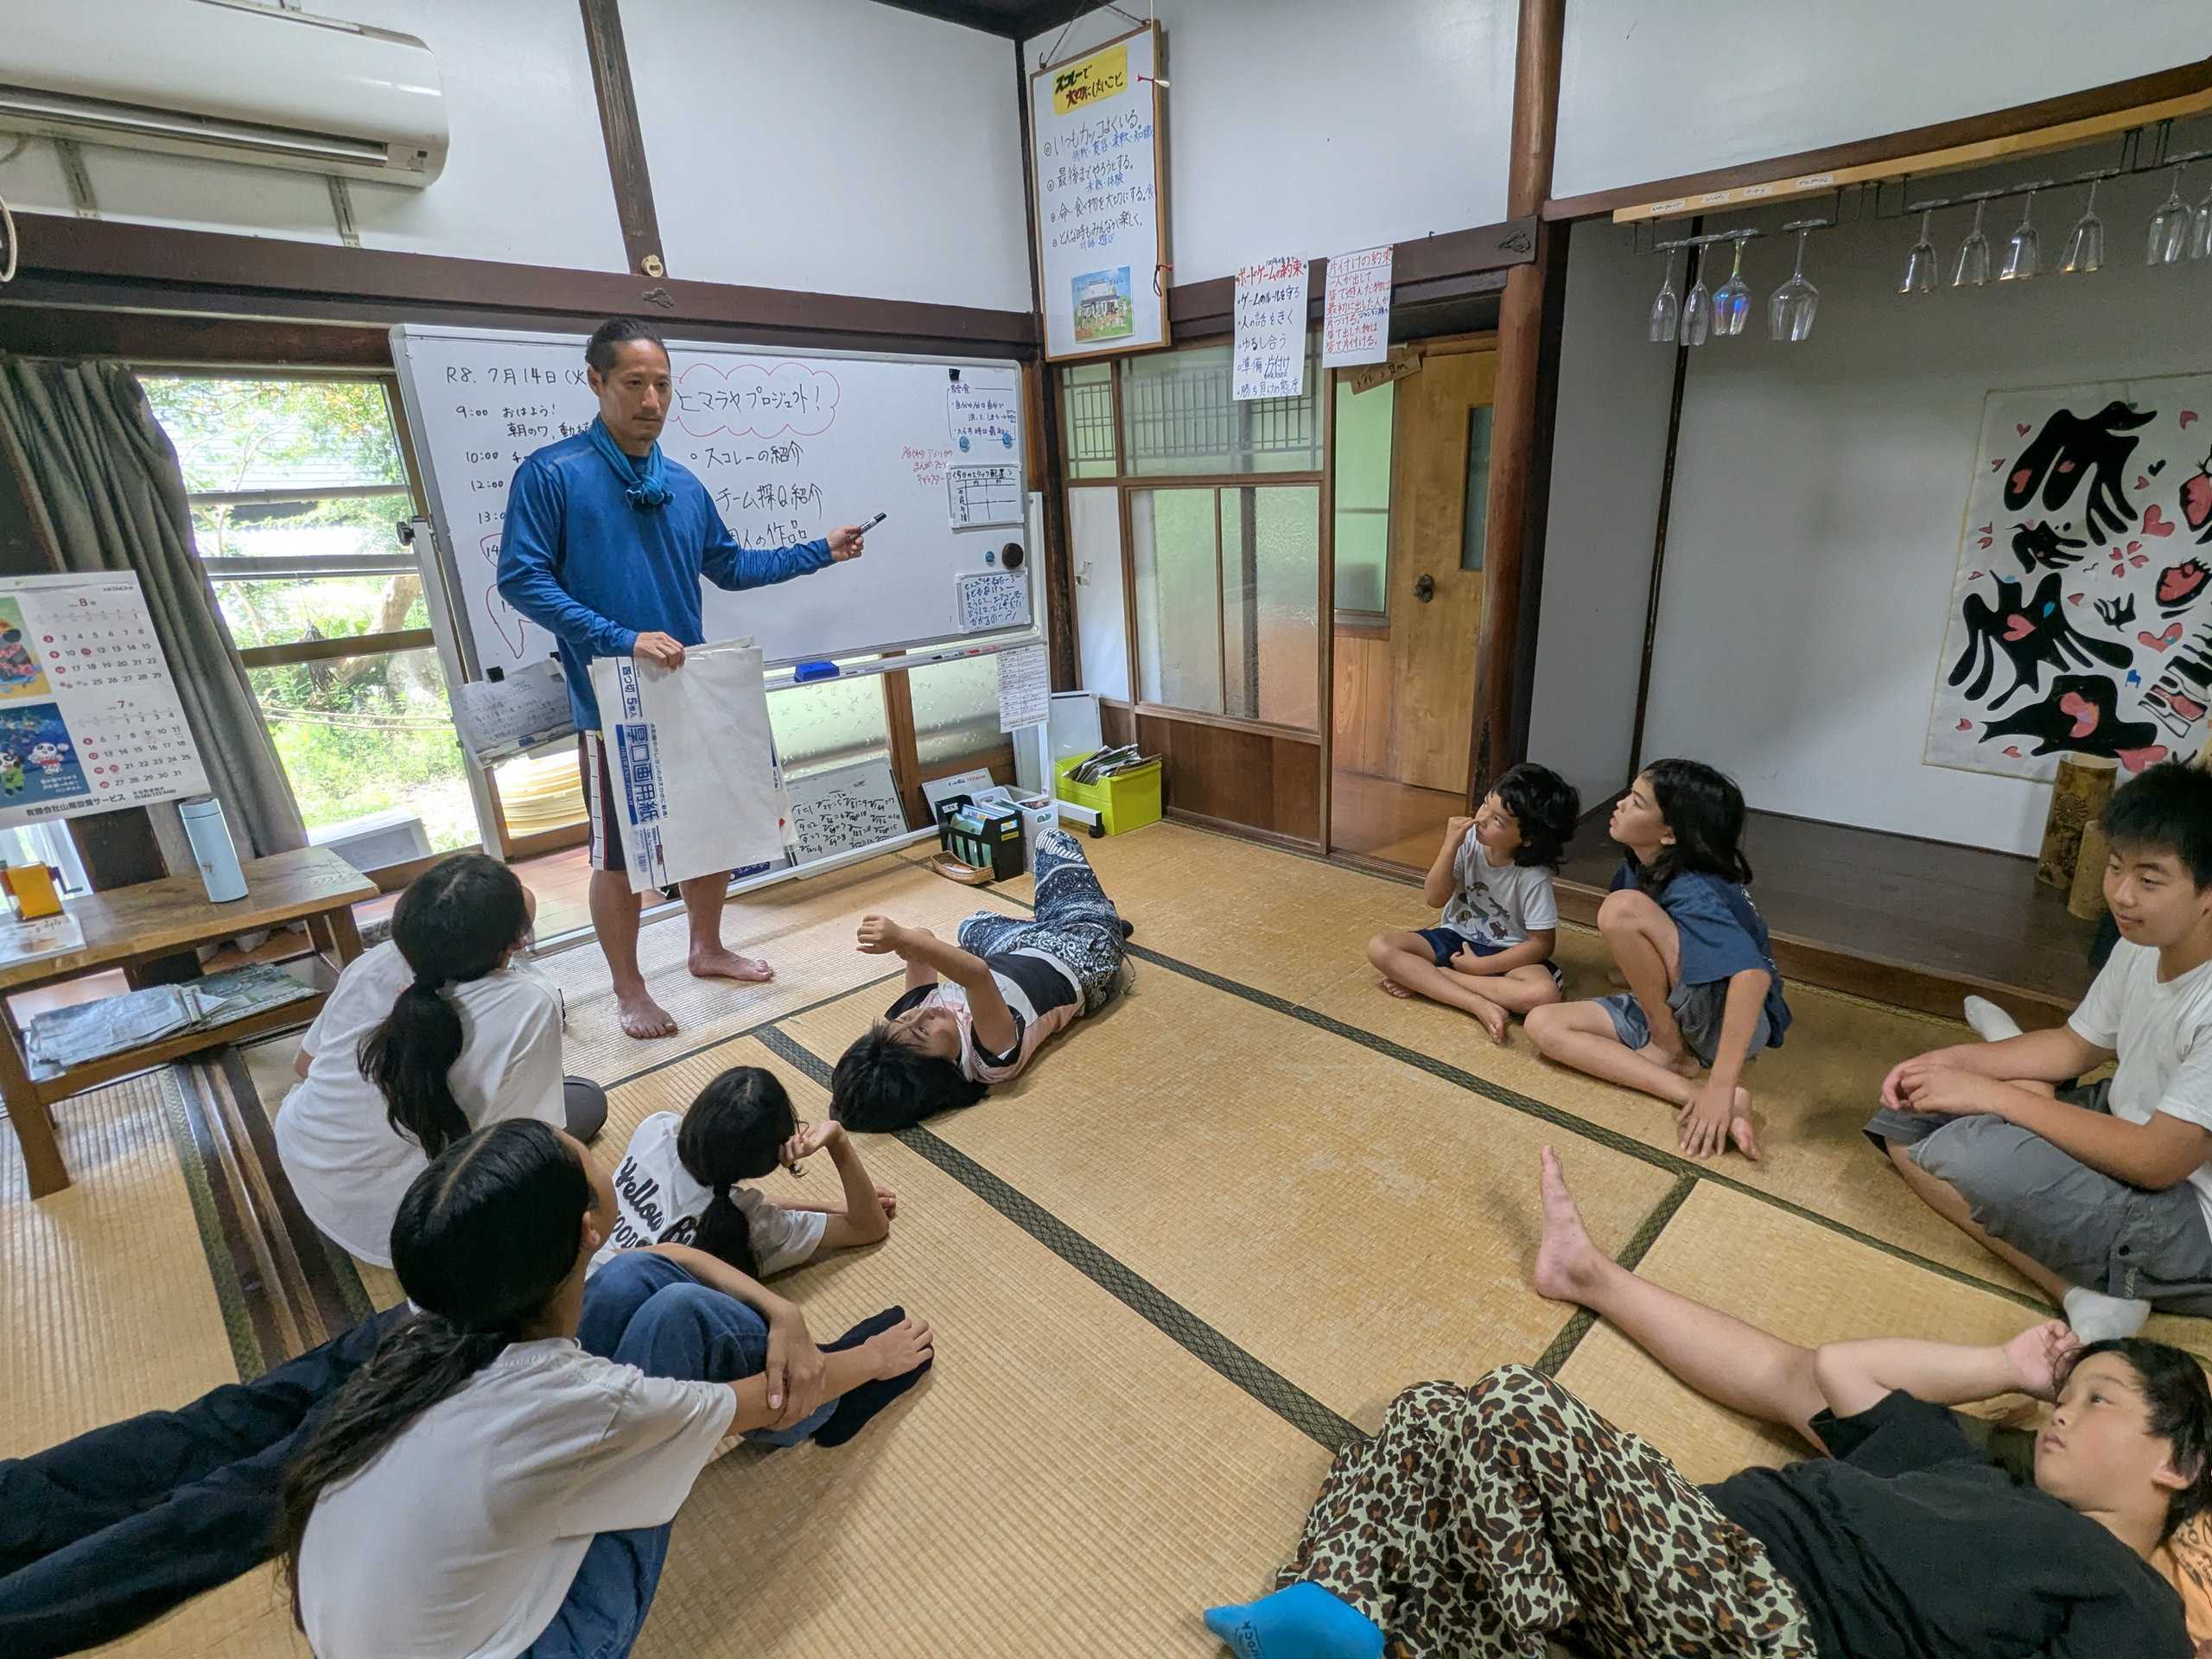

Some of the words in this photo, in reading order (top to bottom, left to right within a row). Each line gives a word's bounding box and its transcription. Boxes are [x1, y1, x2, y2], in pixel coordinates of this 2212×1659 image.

[455, 405, 488, 418] 9:00
[467, 451, 499, 463] 10:00
[471, 480, 504, 493] 12:00
[79, 597, 88, 607] 8
[117, 700, 125, 709] 7
[626, 724, 659, 822] 厚口画用紙
[615, 1155, 664, 1232] Yellow
